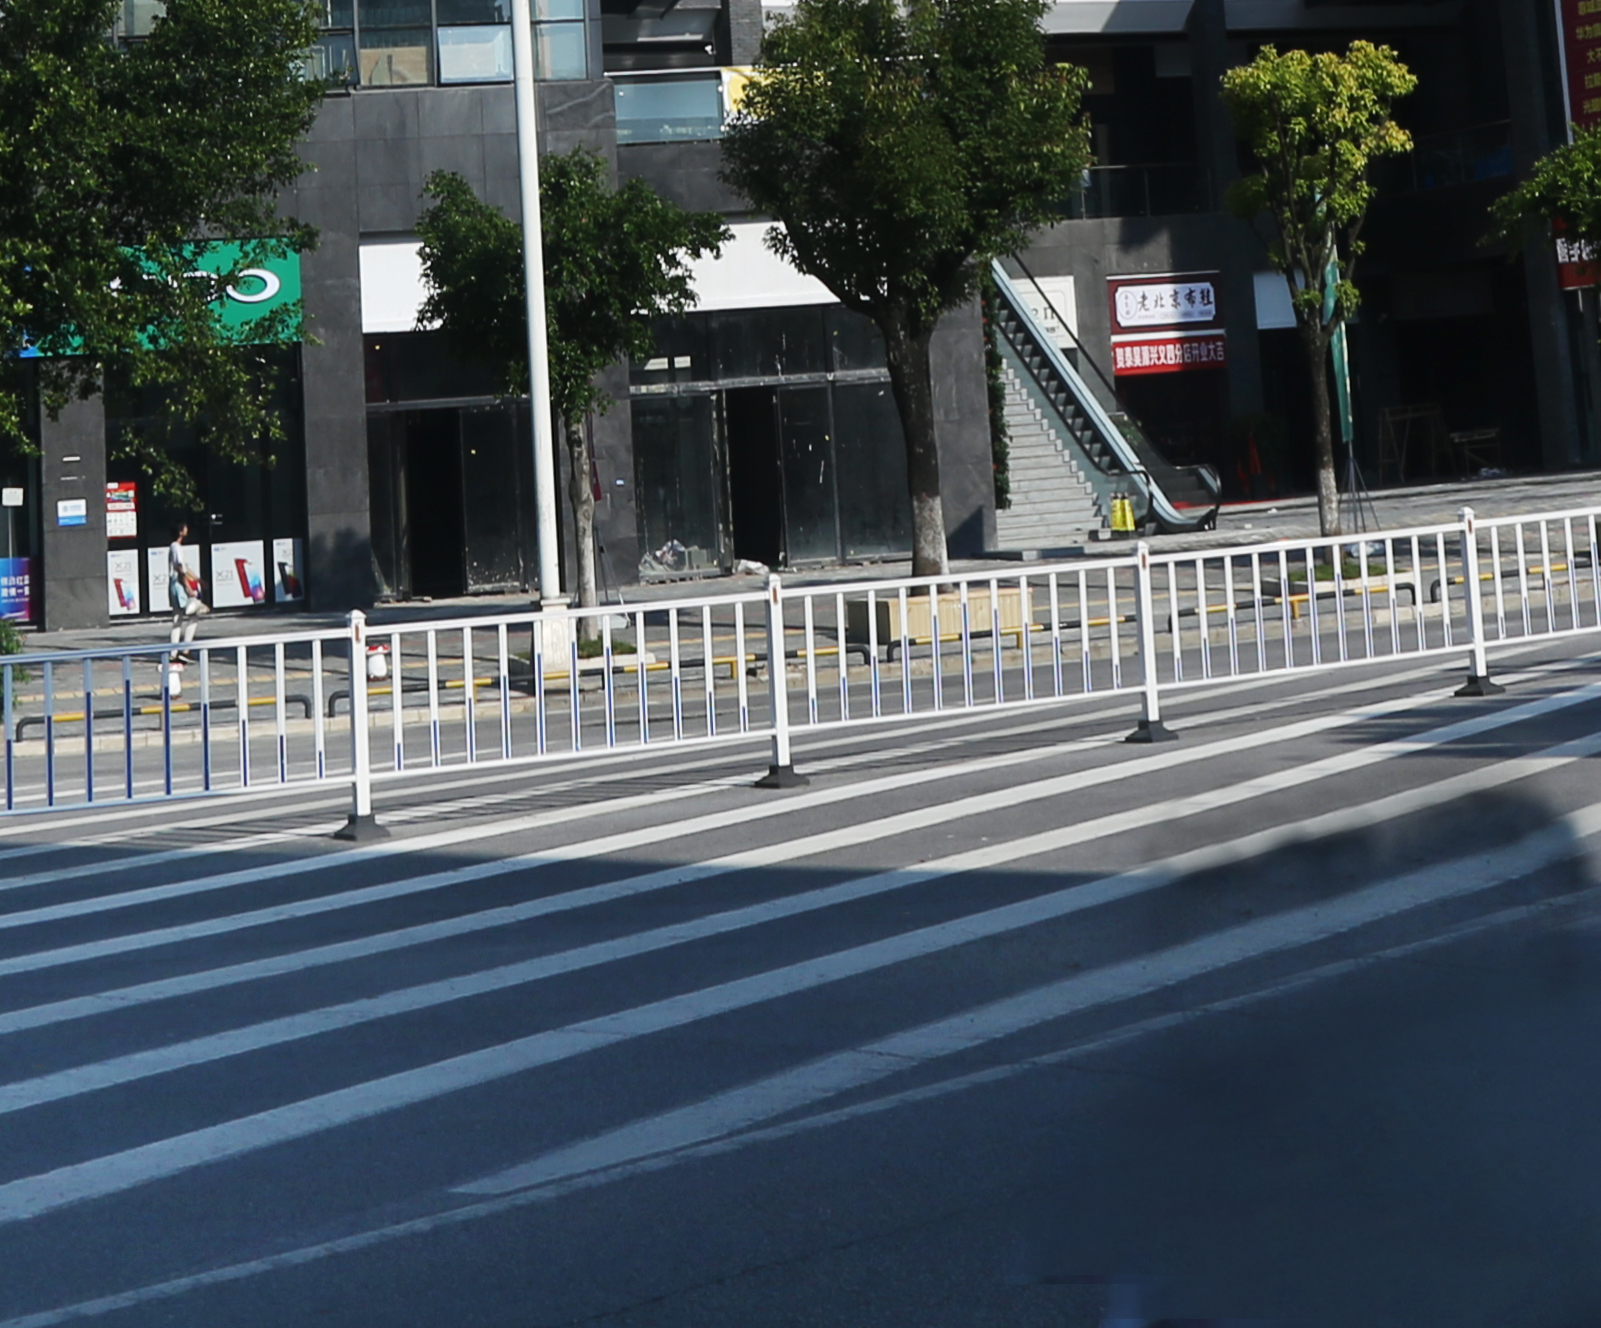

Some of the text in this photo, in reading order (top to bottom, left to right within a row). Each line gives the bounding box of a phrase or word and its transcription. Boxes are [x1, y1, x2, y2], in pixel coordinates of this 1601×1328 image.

[1138, 287, 1212, 312] 老北京布鞋
[115, 561, 132, 572] X21
[216, 570, 234, 581] X21
